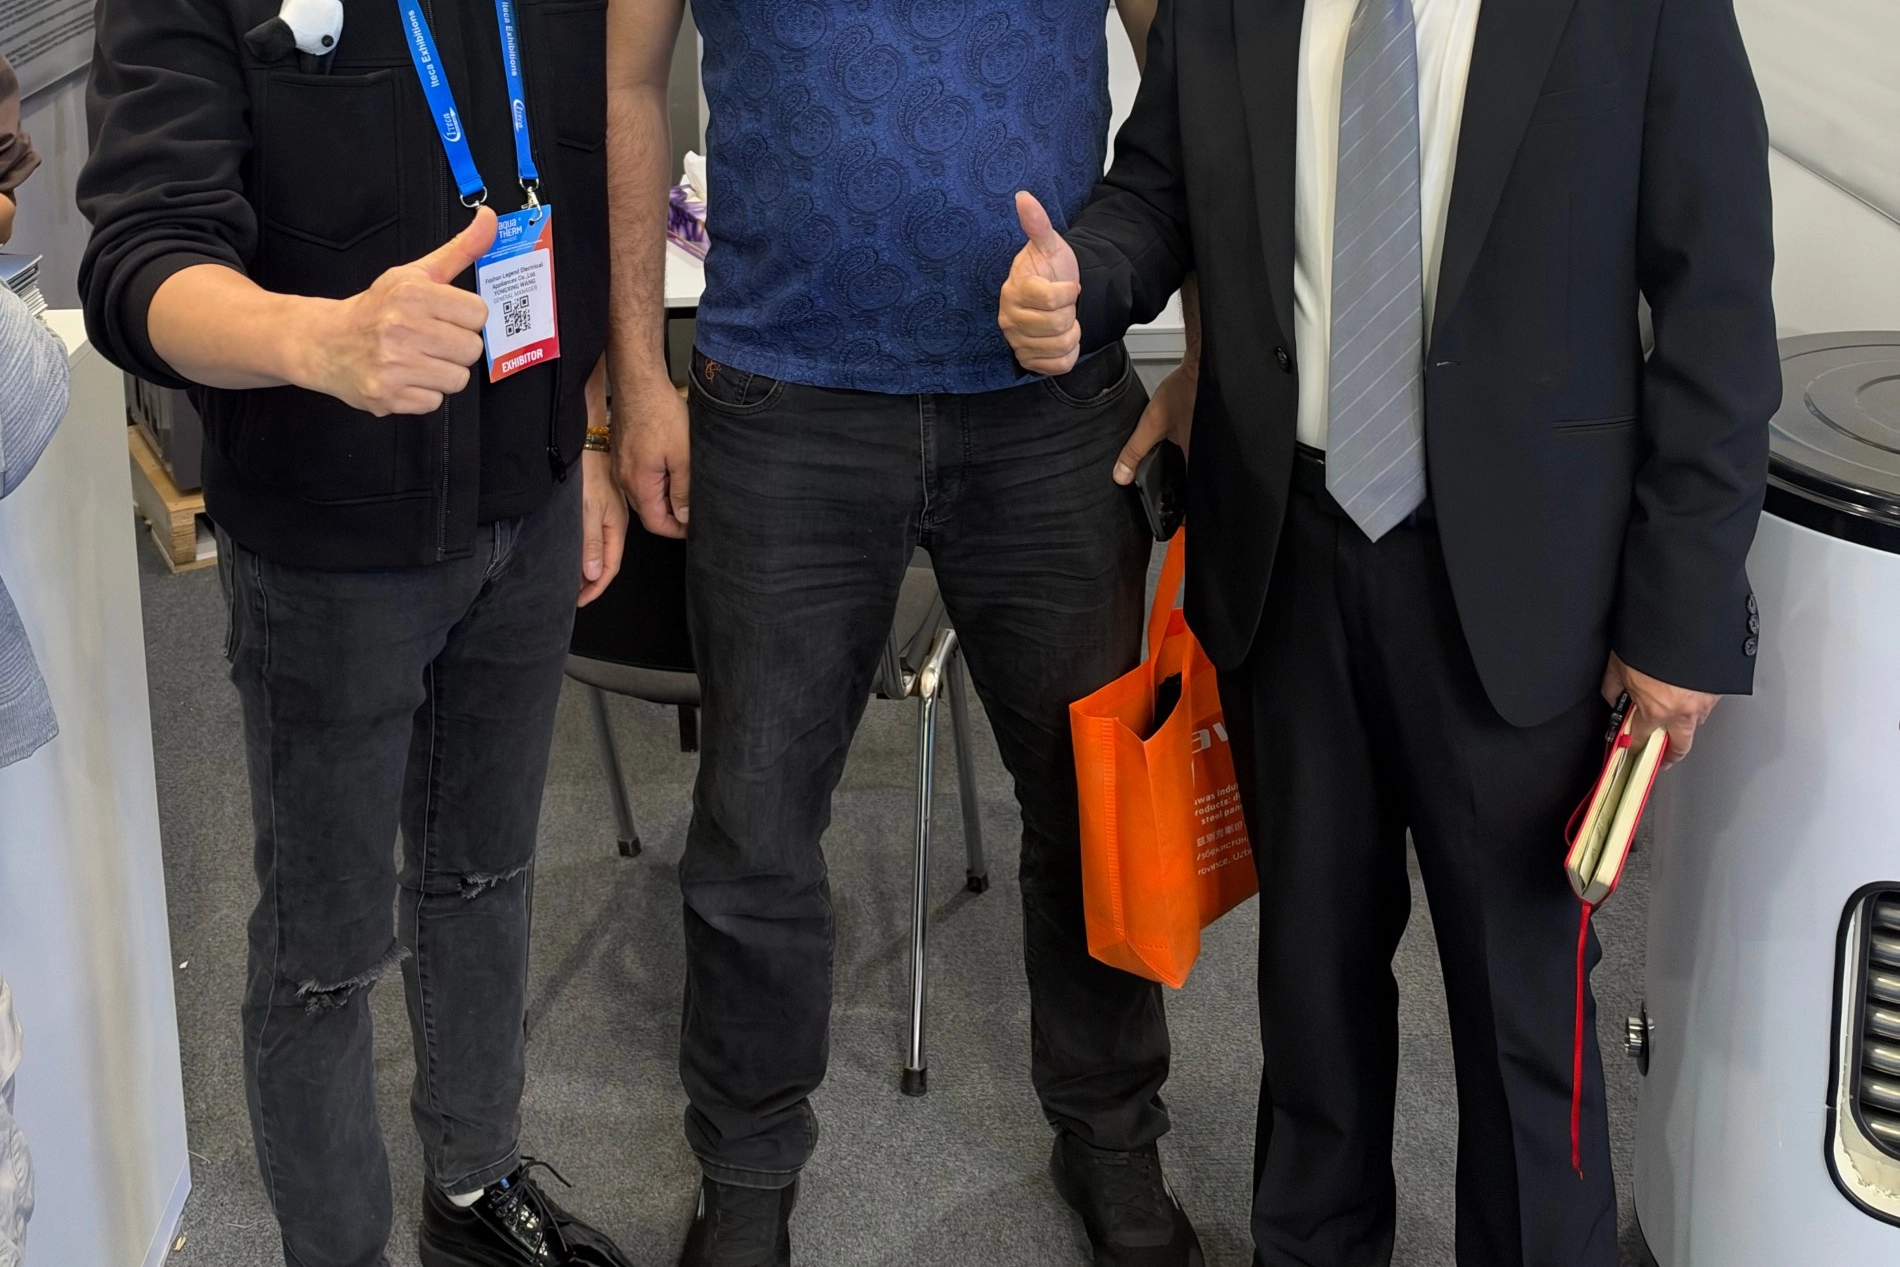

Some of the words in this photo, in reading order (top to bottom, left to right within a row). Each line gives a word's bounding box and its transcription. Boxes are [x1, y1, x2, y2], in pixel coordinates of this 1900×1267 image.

[501, 1, 511, 24] Iteca
[408, 9, 431, 64] Exhibitions
[505, 25, 518, 77] Exhibitions
[426, 63, 440, 88] Iteca
[501, 348, 544, 373] EXHIBITOR
[1201, 809, 1223, 825] steel
